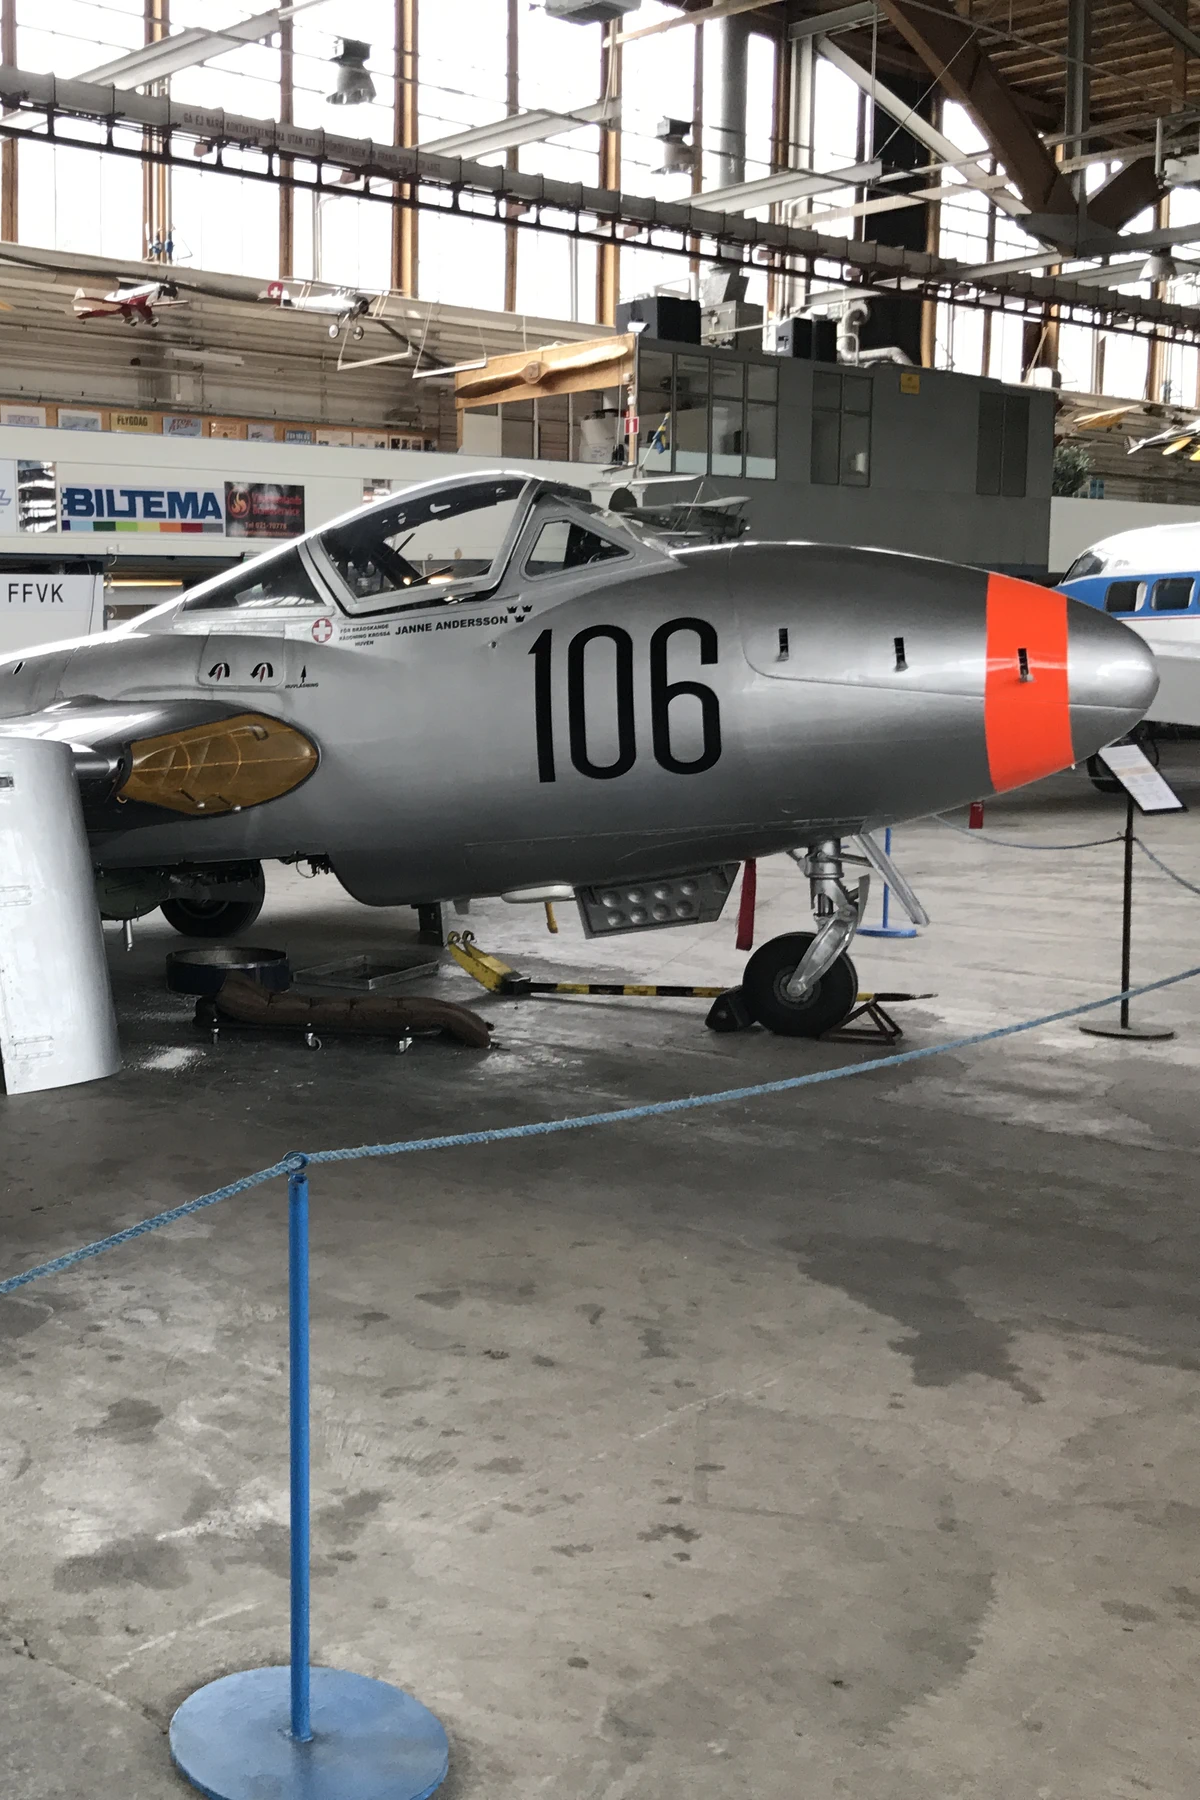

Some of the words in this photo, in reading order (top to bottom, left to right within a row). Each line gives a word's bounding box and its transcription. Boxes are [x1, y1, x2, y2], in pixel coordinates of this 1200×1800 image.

[195, 114, 204, 126] EJ
[287, 133, 303, 144] UTAN
[305, 137, 316, 147] ATT
[117, 415, 148, 427] FLYGDAG
[62, 487, 223, 519] BILTEMA
[8, 583, 64, 603] FFVK
[395, 622, 433, 636] JANNE
[435, 615, 509, 631] ANDERSSON
[528, 617, 722, 783] 106
